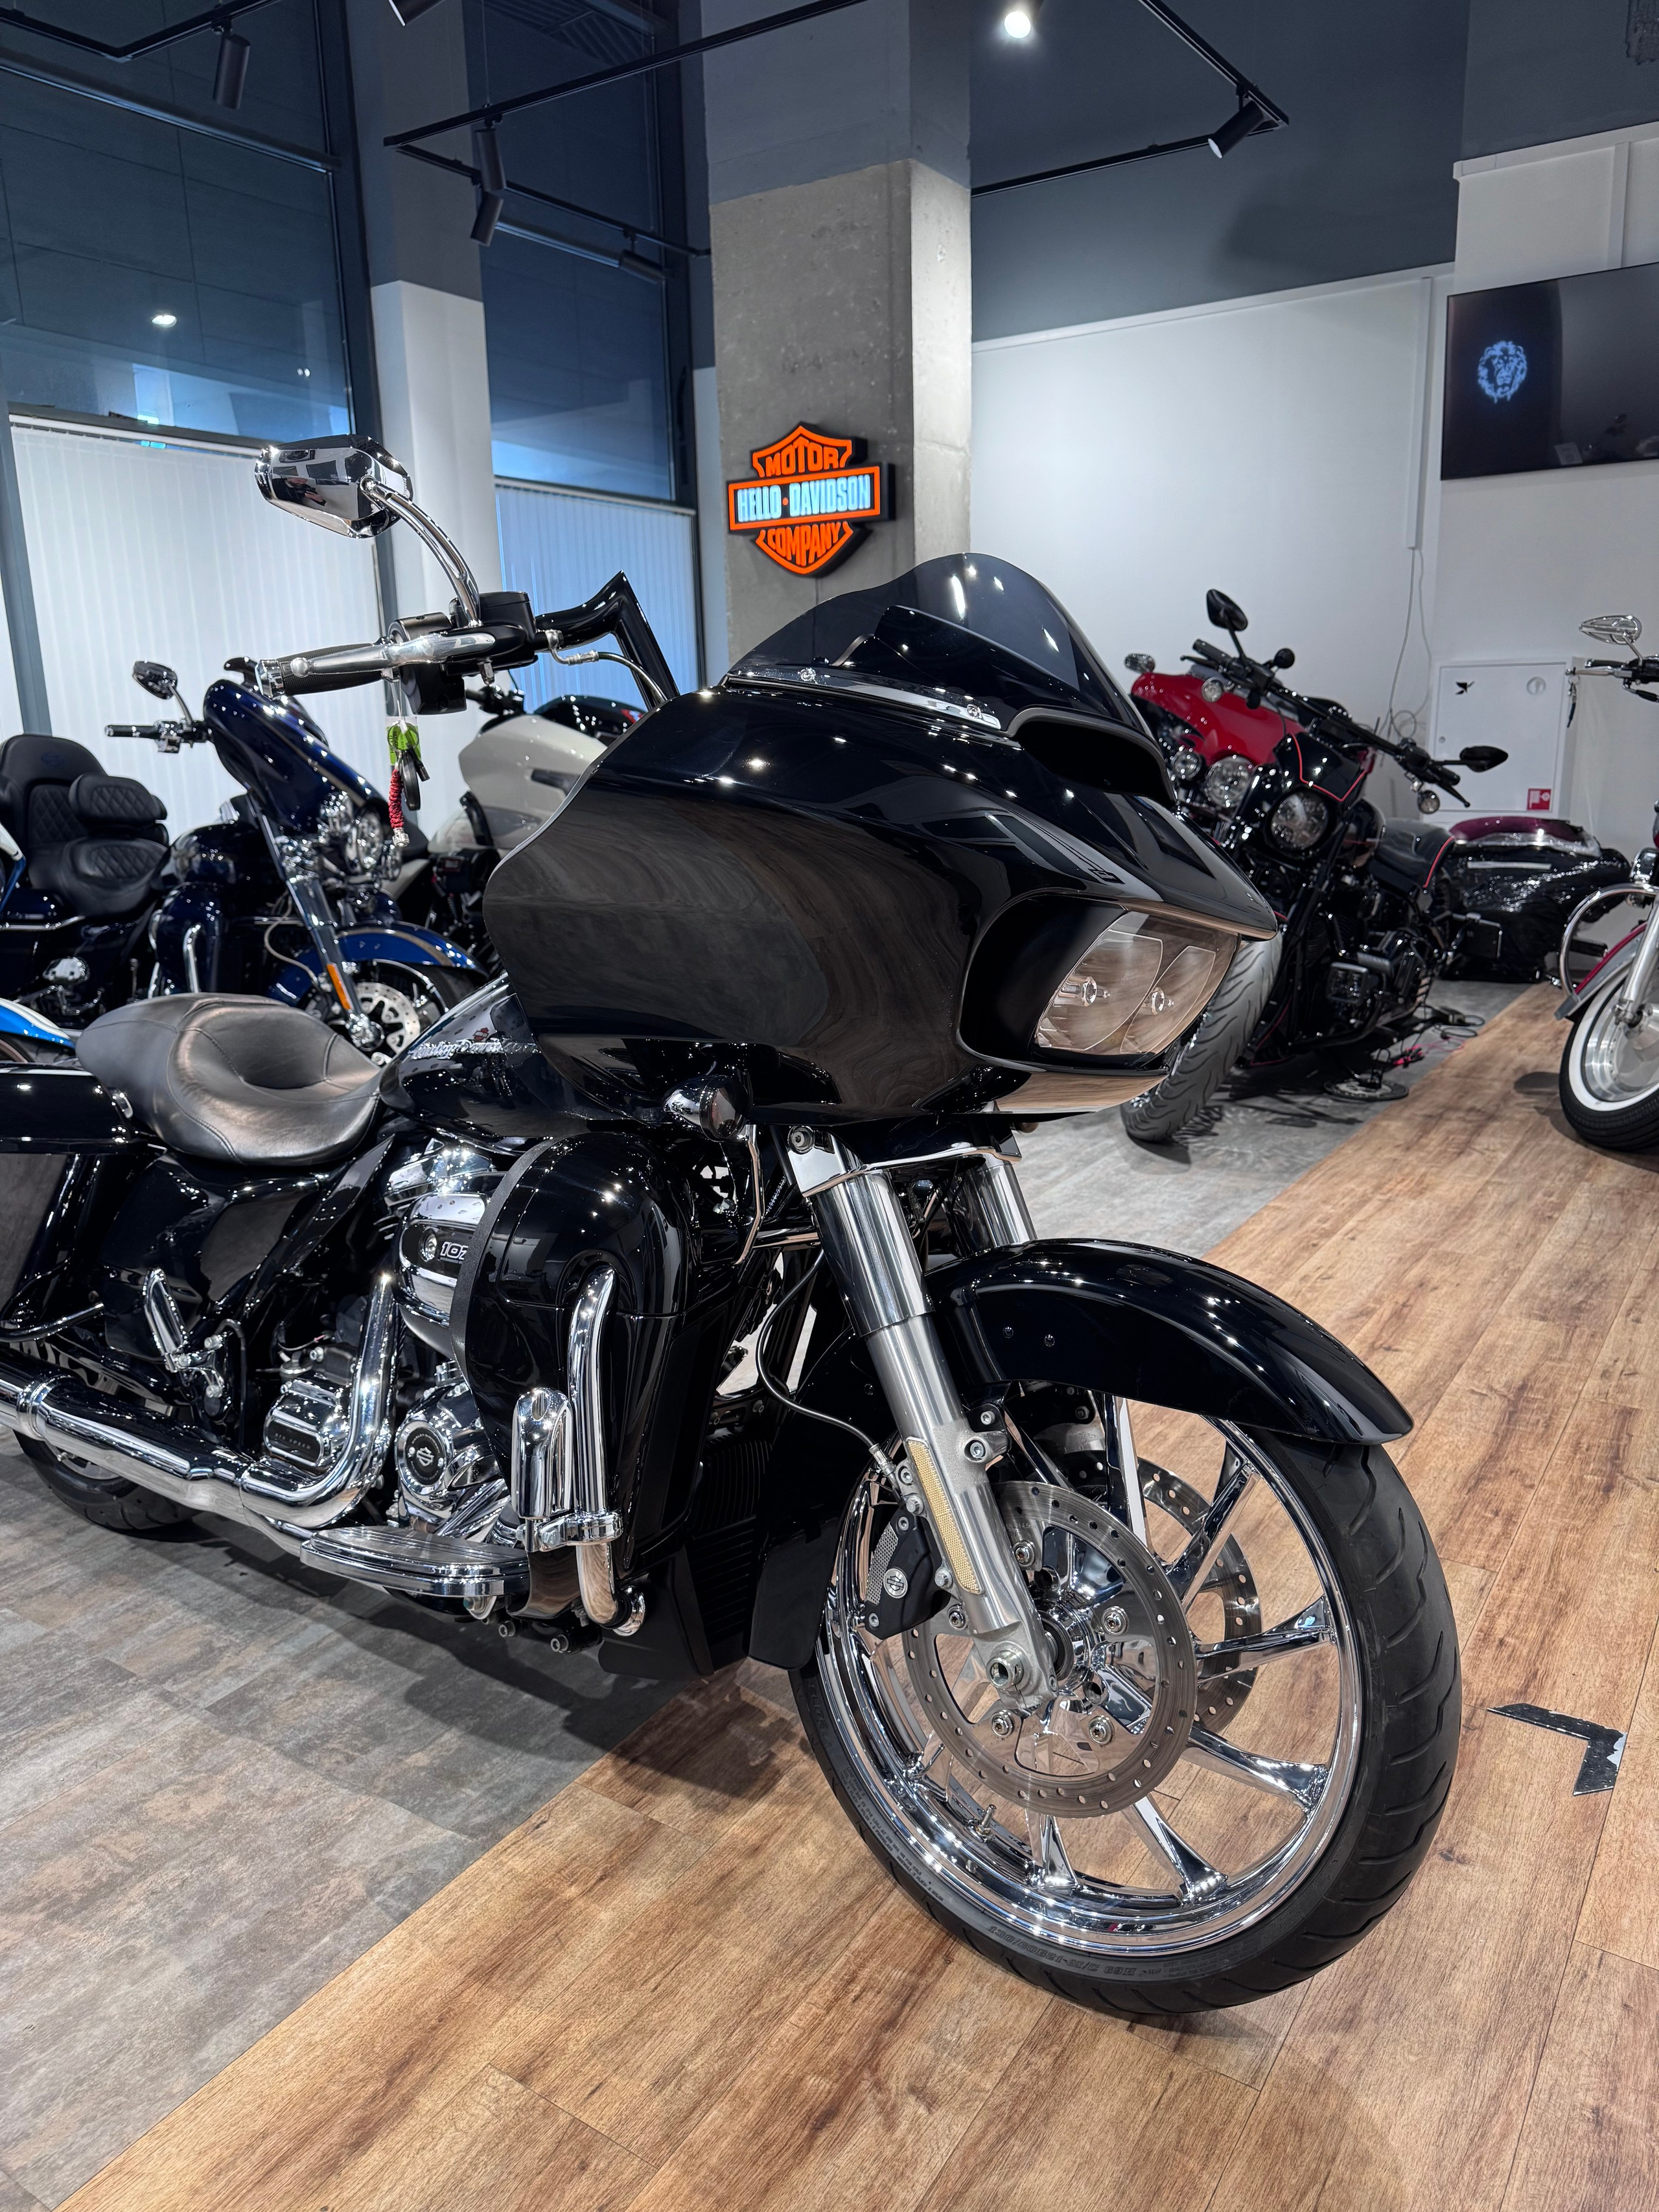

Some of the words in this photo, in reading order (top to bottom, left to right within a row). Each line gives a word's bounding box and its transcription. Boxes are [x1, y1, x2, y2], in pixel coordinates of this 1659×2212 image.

[765, 436, 839, 477] MOTOR
[737, 485, 782, 522] HELLO
[789, 474, 870, 517] DAVIDSON
[767, 522, 841, 566] COMPANY
[289, 1438, 311, 1449] SPEED
